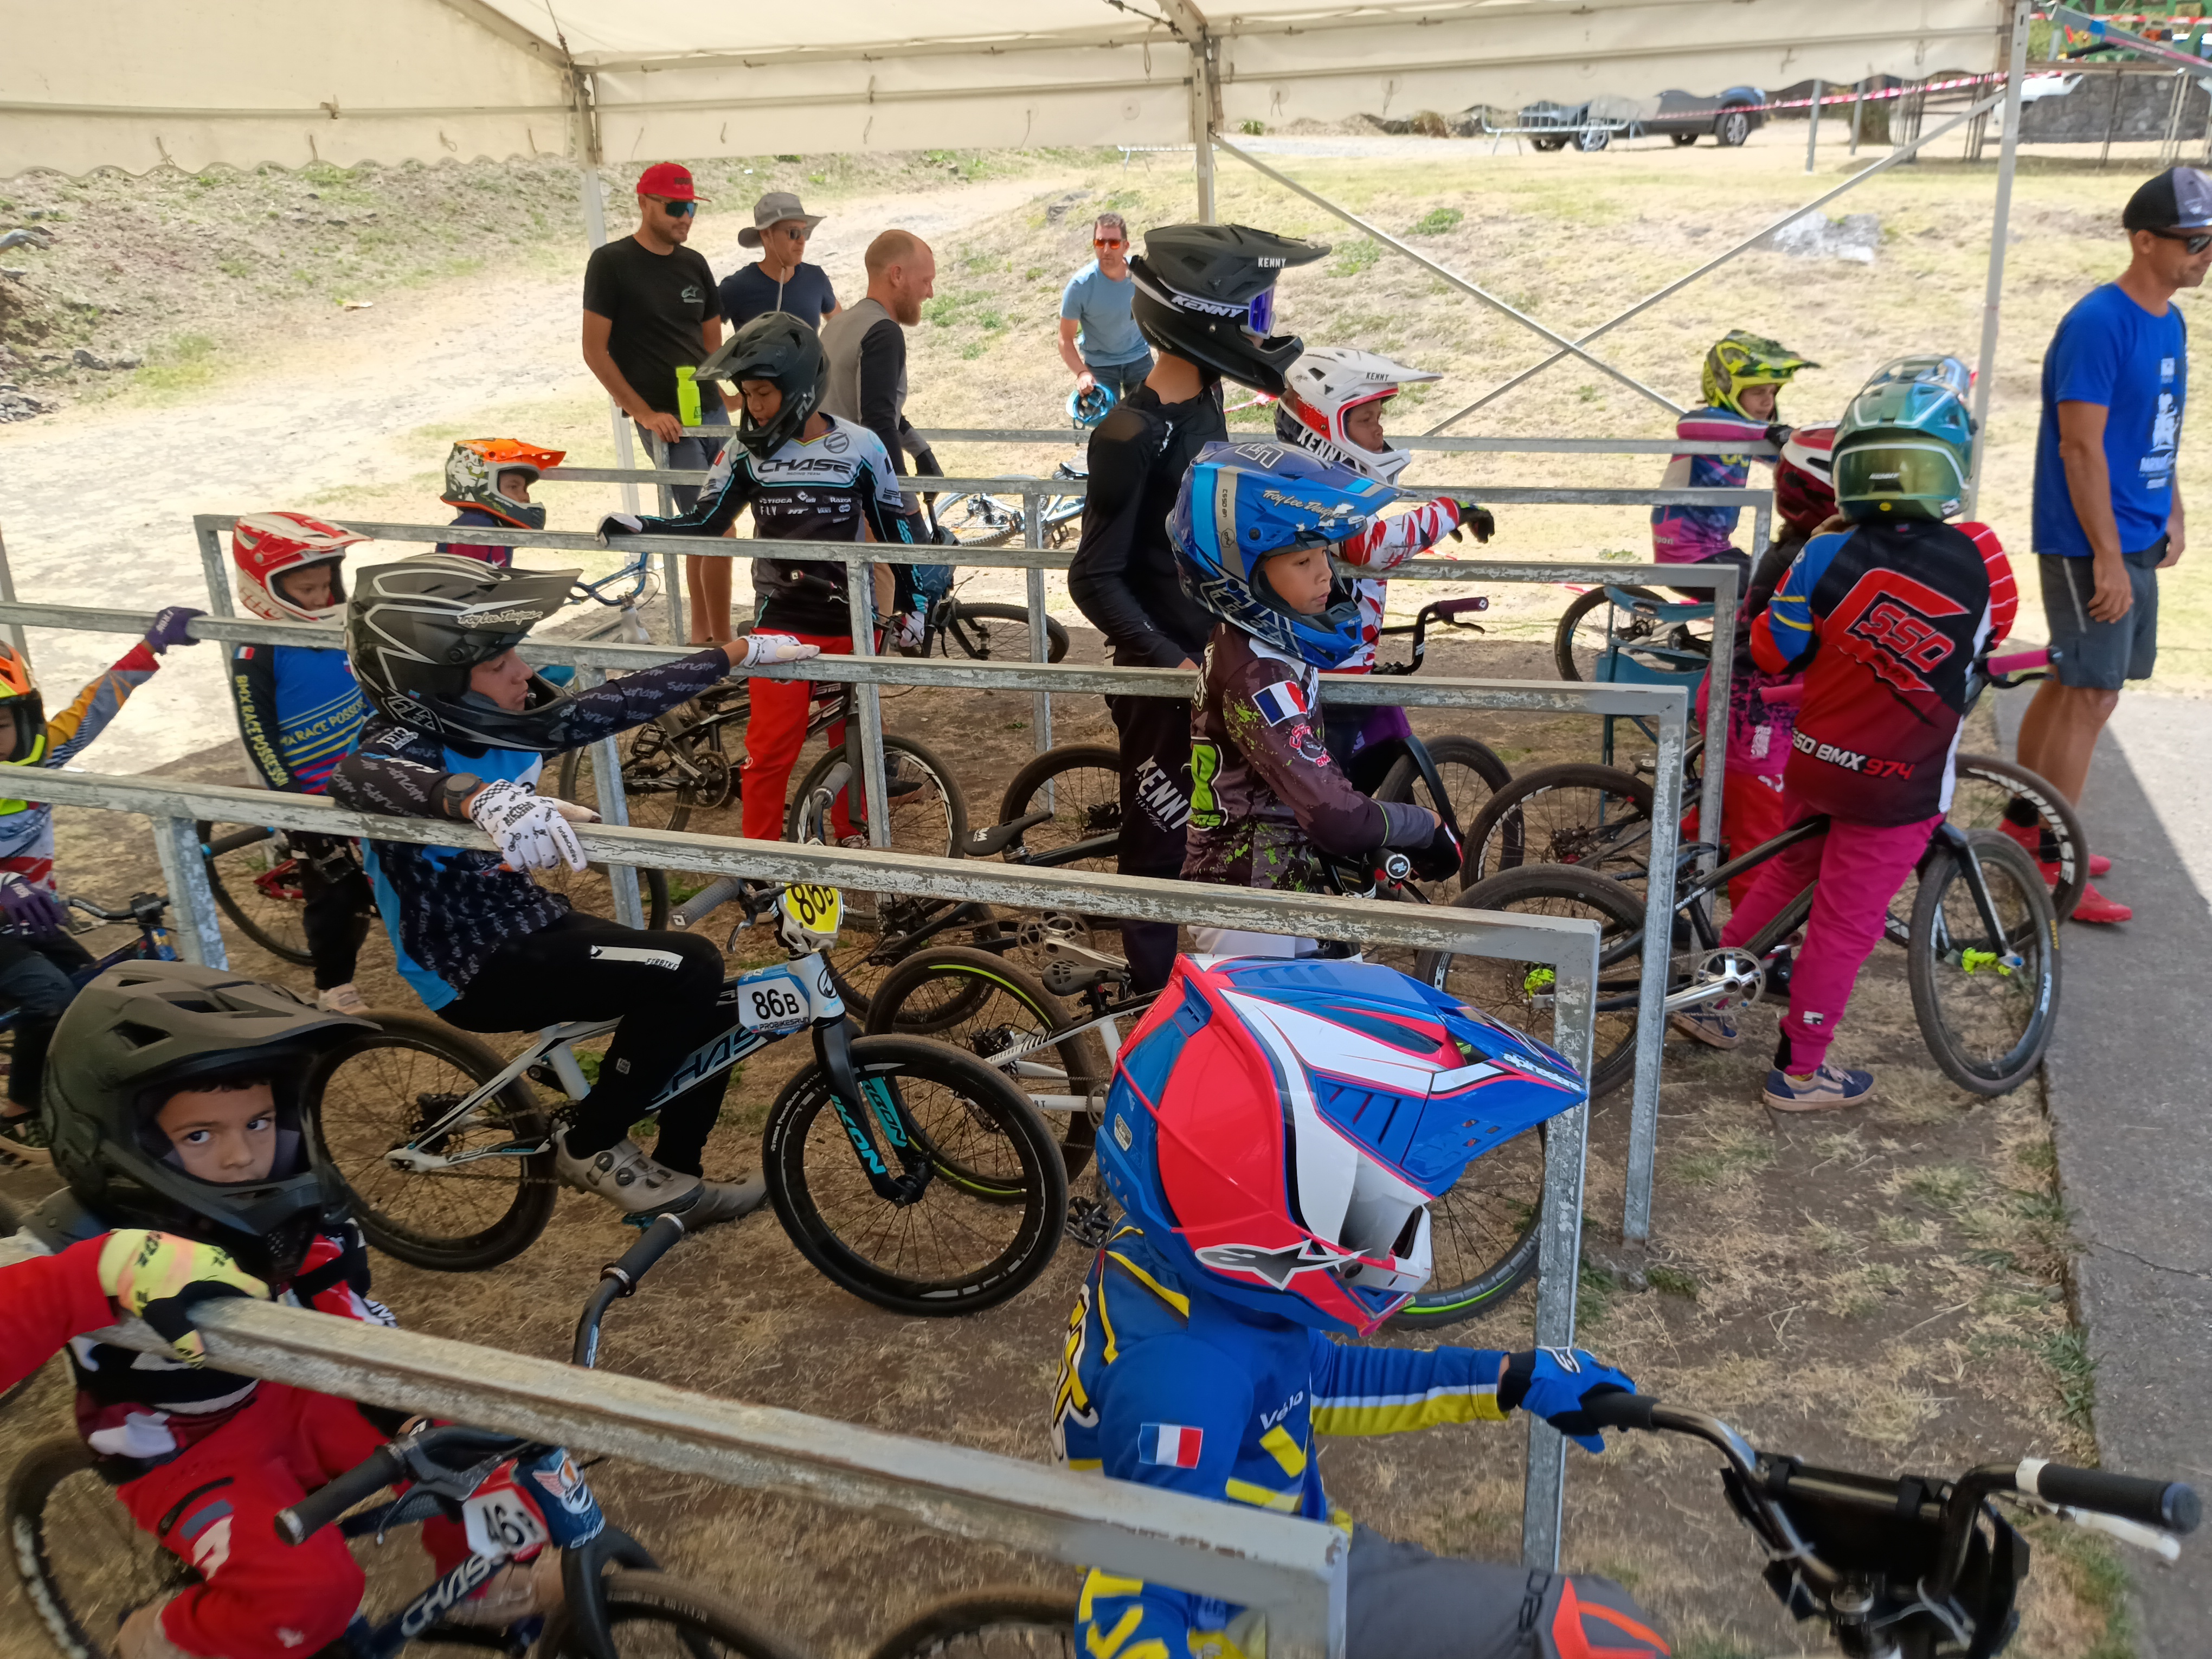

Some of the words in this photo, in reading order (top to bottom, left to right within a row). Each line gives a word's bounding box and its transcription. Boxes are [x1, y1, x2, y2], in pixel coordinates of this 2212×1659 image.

[1258, 257, 1287, 268] KENNY
[1172, 295, 1244, 318] KENNY
[1366, 372, 1389, 382] KENNY
[1297, 426, 1349, 462] KENNY
[757, 459, 852, 474] CHASE
[761, 506, 776, 516] FLY
[1284, 494, 1304, 508] Lee
[235, 674, 253, 704] BMX
[242, 704, 263, 736] RACE
[295, 719, 330, 742] RACE
[1815, 743, 1866, 771] BMX
[1863, 758, 1916, 780] 974
[830, 1094, 887, 1174] IKON
[1259, 1390, 1303, 1430] Vélo
